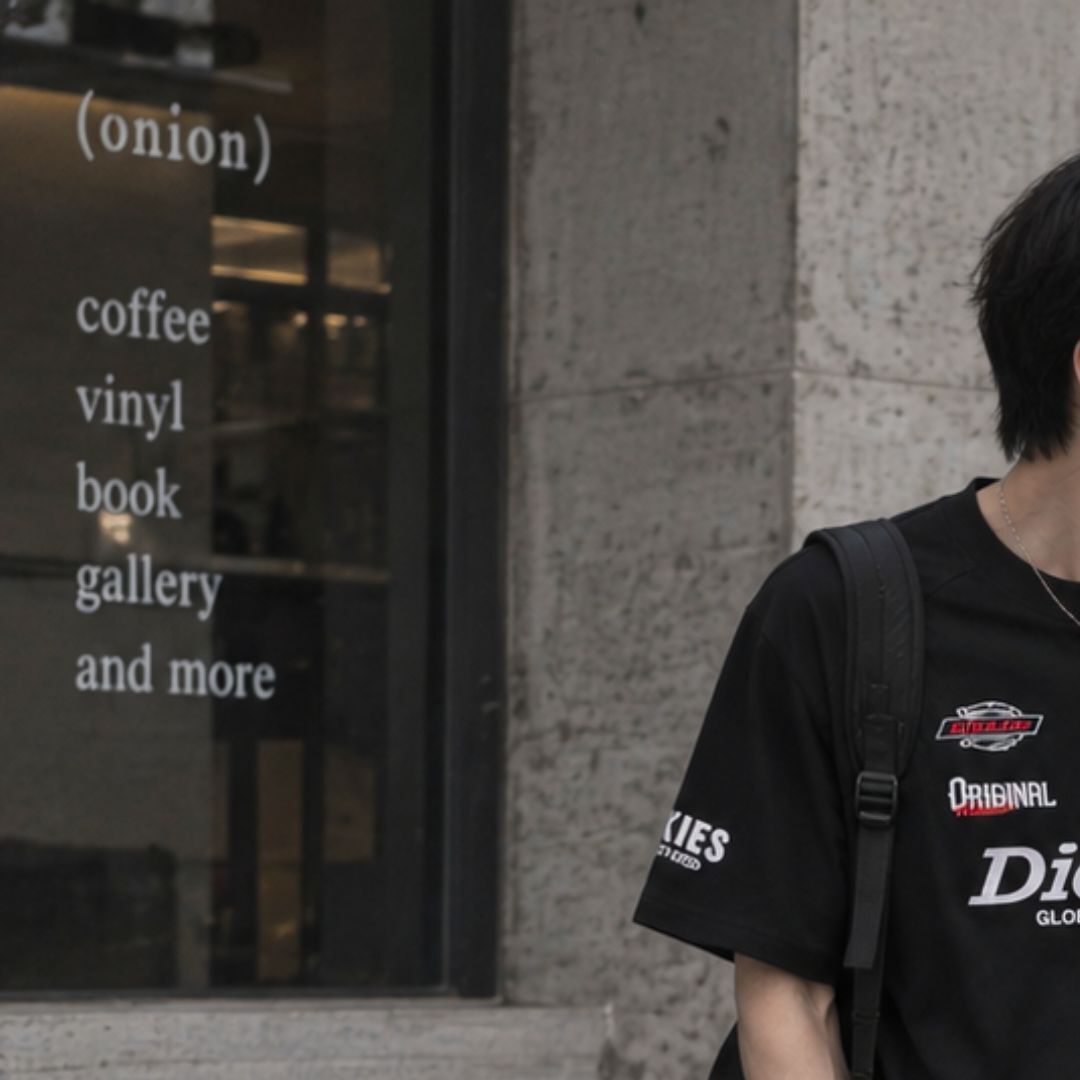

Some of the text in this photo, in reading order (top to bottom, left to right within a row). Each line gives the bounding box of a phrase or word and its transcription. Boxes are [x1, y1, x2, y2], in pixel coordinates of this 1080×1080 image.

[77, 89, 271, 185] (onion)
[76, 287, 210, 345] coffee
[76, 373, 184, 441] vinyl
[76, 461, 182, 519] book
[76, 553, 222, 621] gallery
[76, 642, 276, 700] and more
